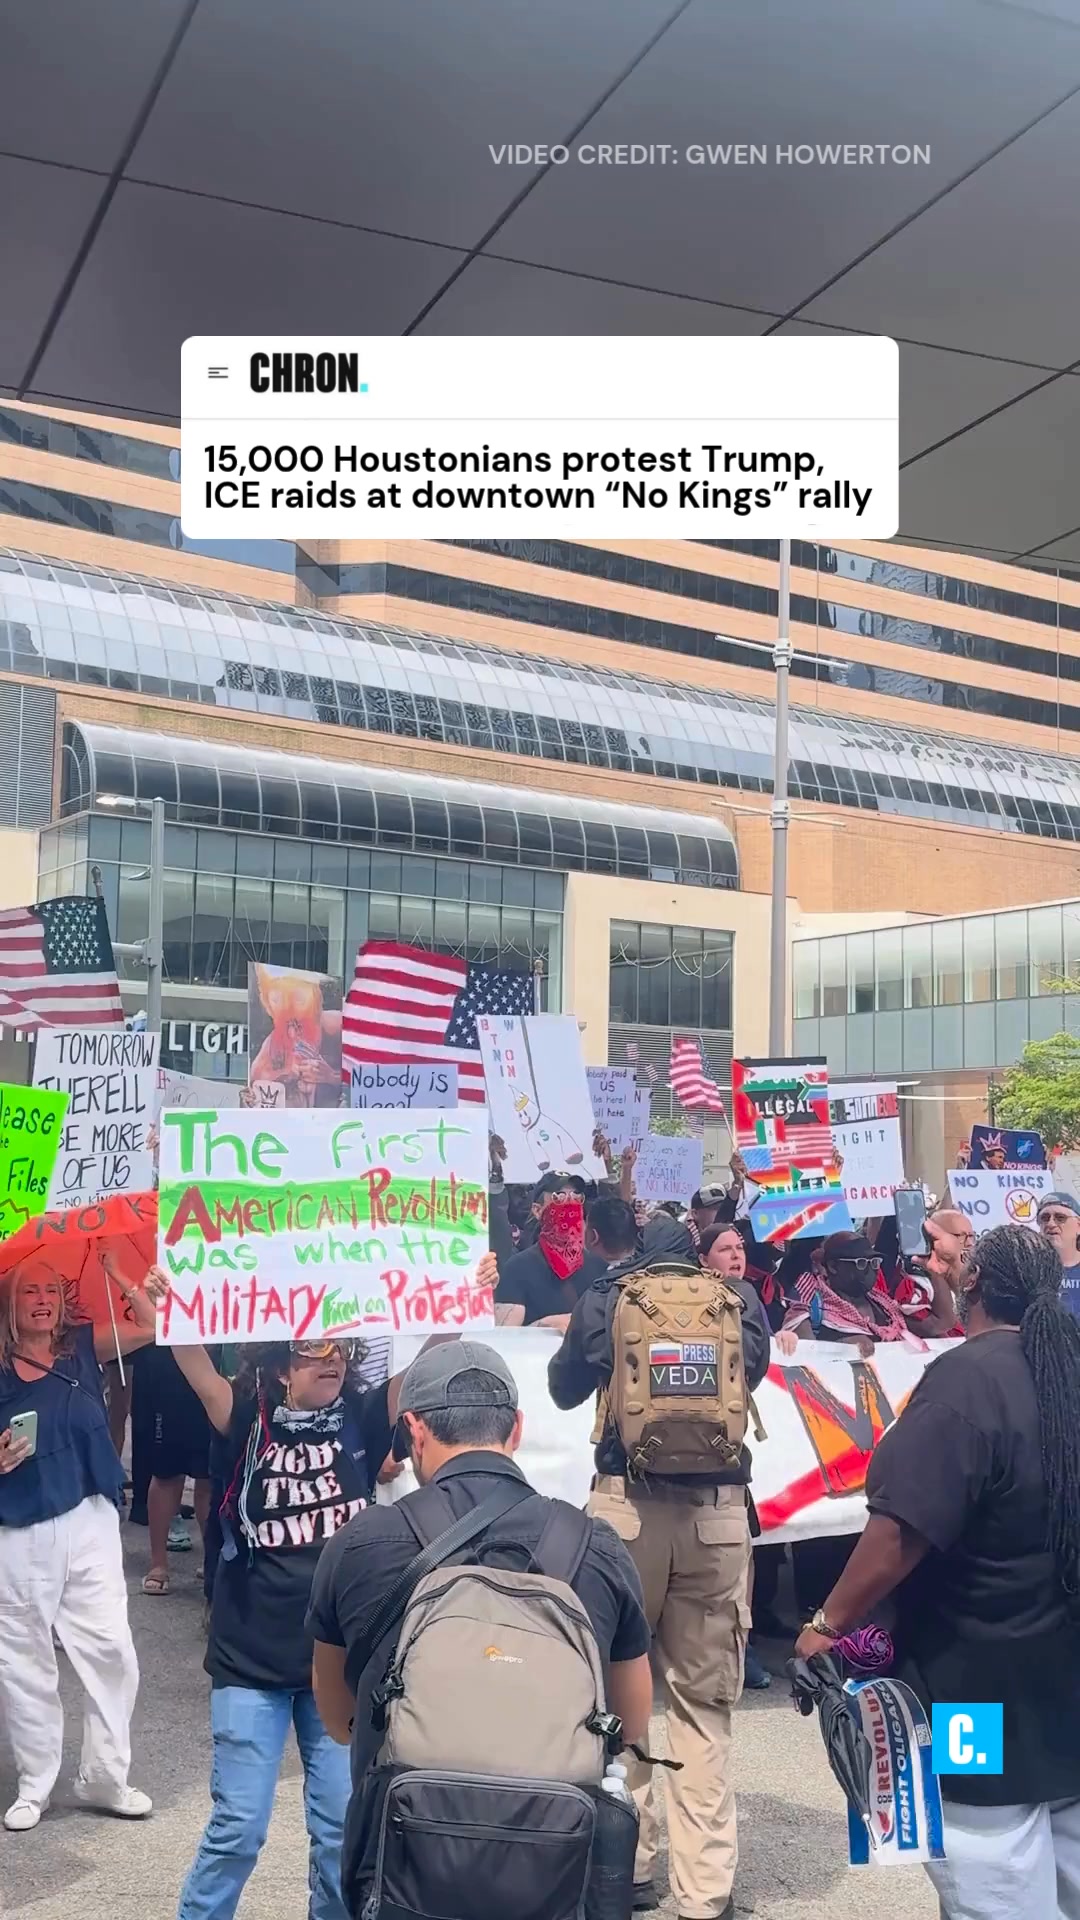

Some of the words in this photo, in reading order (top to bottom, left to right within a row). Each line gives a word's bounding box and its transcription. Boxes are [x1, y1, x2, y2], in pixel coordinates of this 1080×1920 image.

[54, 1032, 155, 1067] TOMORROW
[352, 1064, 421, 1097] Nobody
[429, 1072, 449, 1093] is
[600, 1080, 616, 1092] US
[92, 1122, 145, 1153] MORE
[164, 1111, 289, 1178] The
[8, 1157, 49, 1195] Files
[62, 1157, 97, 1189] OF
[102, 1154, 131, 1188] US
[953, 1175, 979, 1188] NO
[997, 1174, 1044, 1188] KINGS
[957, 1199, 990, 1216] NO
[294, 1231, 388, 1264] when
[396, 1231, 473, 1266] the
[683, 1344, 715, 1361] PRESS
[651, 1365, 717, 1386] VEDA
[262, 1469, 342, 1510] THE
[898, 1775, 913, 1844] FIGHT
